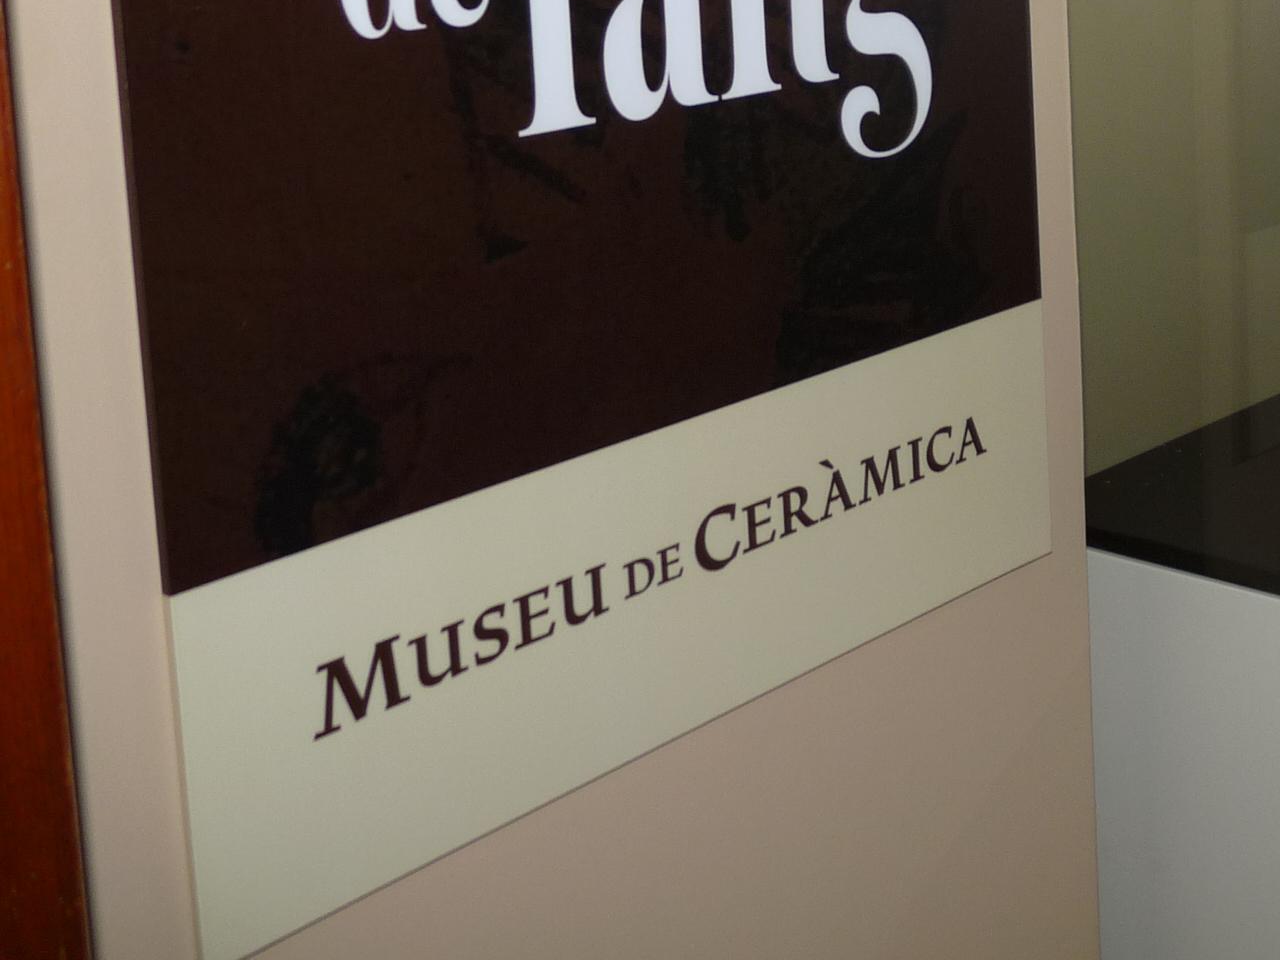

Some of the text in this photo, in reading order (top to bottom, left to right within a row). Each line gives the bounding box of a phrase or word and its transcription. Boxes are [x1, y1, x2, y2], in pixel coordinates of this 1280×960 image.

[313, 416, 987, 741] MUSEU DE CERÀMICA
